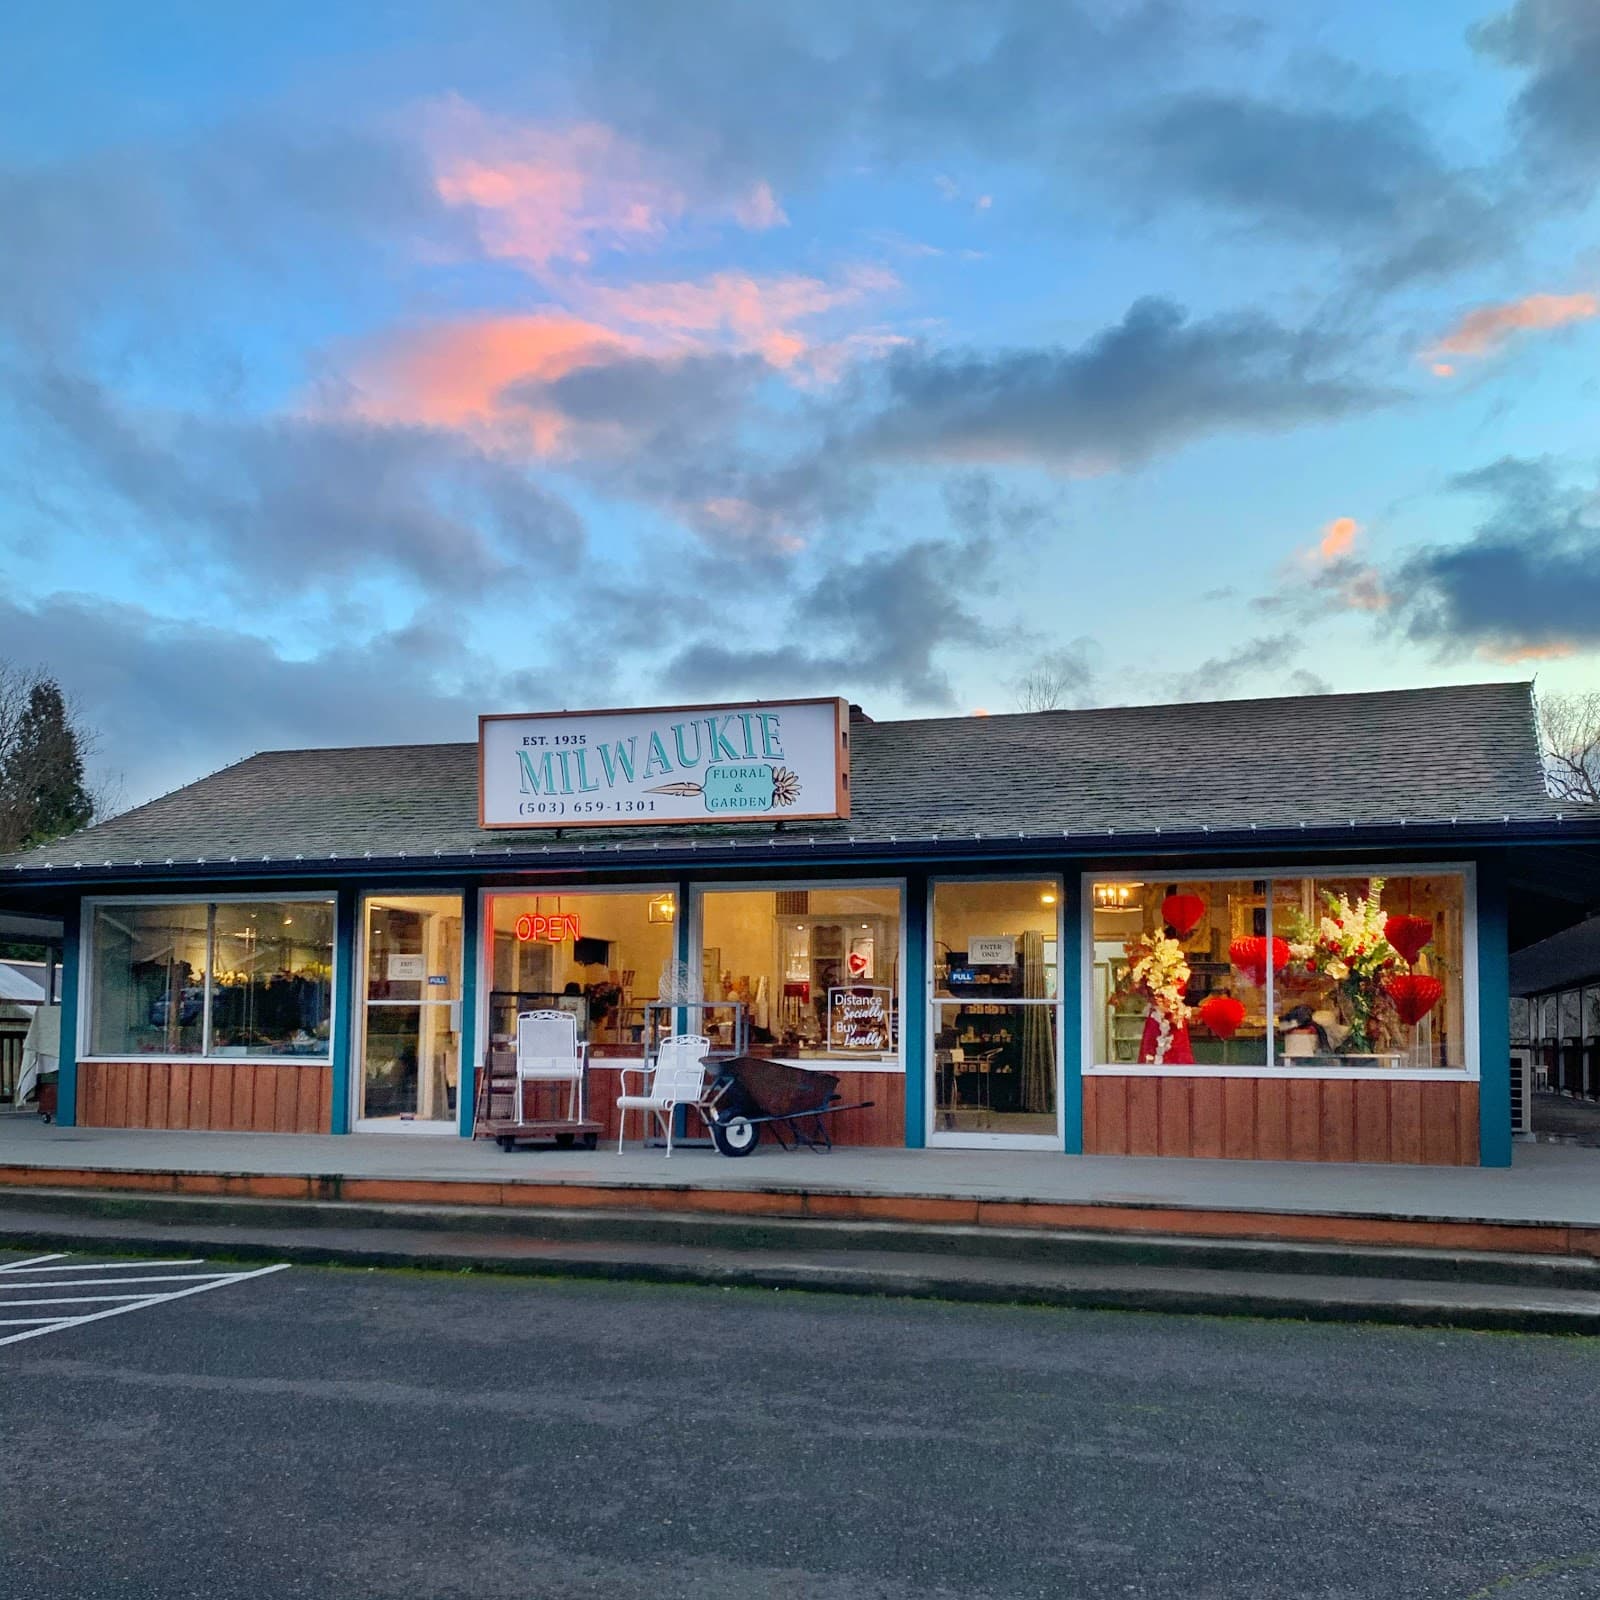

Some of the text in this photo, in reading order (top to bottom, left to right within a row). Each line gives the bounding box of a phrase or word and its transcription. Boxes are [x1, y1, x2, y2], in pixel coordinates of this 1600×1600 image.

[522, 735, 587, 746] EST. 1935
[515, 712, 785, 796] MILWAUKIE
[713, 768, 766, 779] FLORAL
[734, 783, 744, 793] &
[519, 800, 657, 815] (503) 659-1301
[711, 797, 767, 808] GARDEN
[515, 914, 580, 941] OPEN
[952, 973, 972, 981] PULL
[835, 994, 883, 1006] Distance
[843, 1005, 884, 1022] Socially
[836, 1021, 857, 1036] Buy
[844, 1032, 883, 1049] Locally
